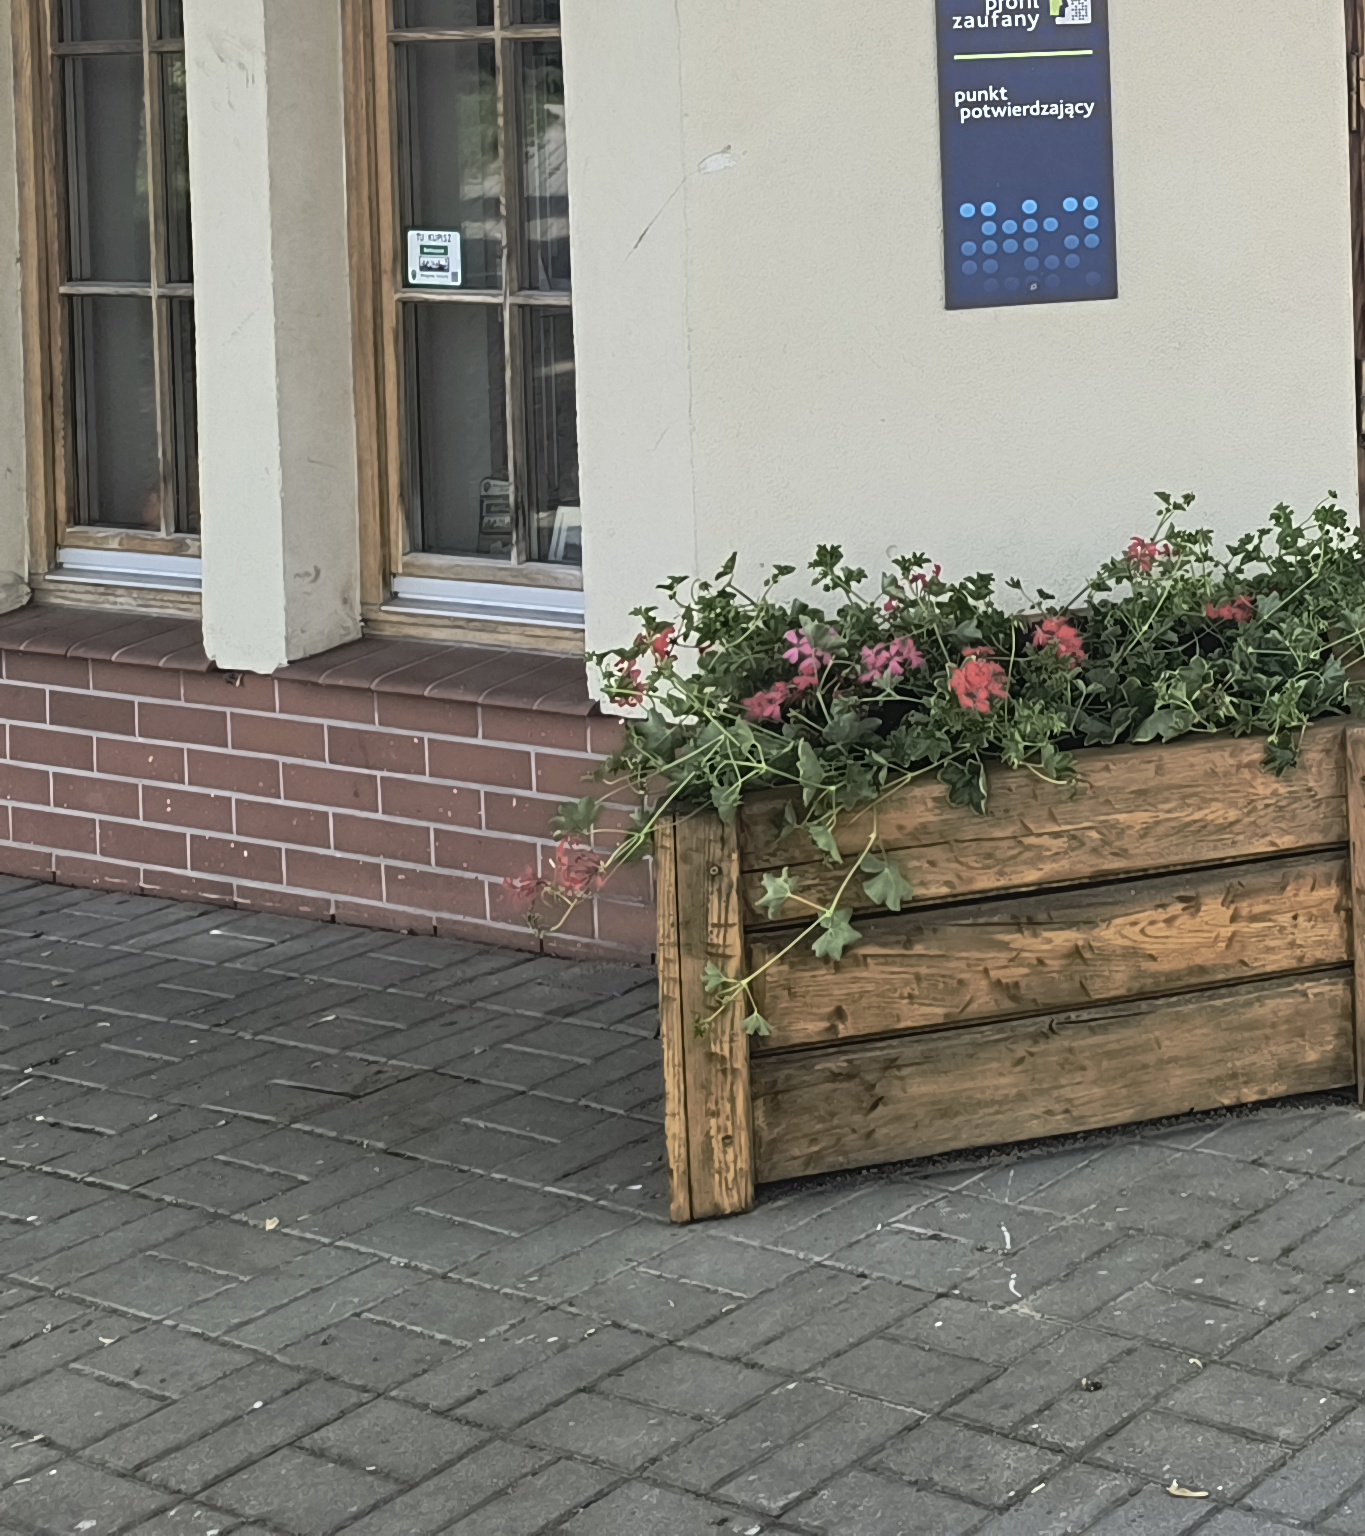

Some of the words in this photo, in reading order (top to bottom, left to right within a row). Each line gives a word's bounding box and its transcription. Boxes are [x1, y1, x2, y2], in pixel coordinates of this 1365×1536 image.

[952, 11, 1040, 32] zaufany
[954, 86, 1008, 107] punkt
[960, 99, 1094, 124] potwierdzający
